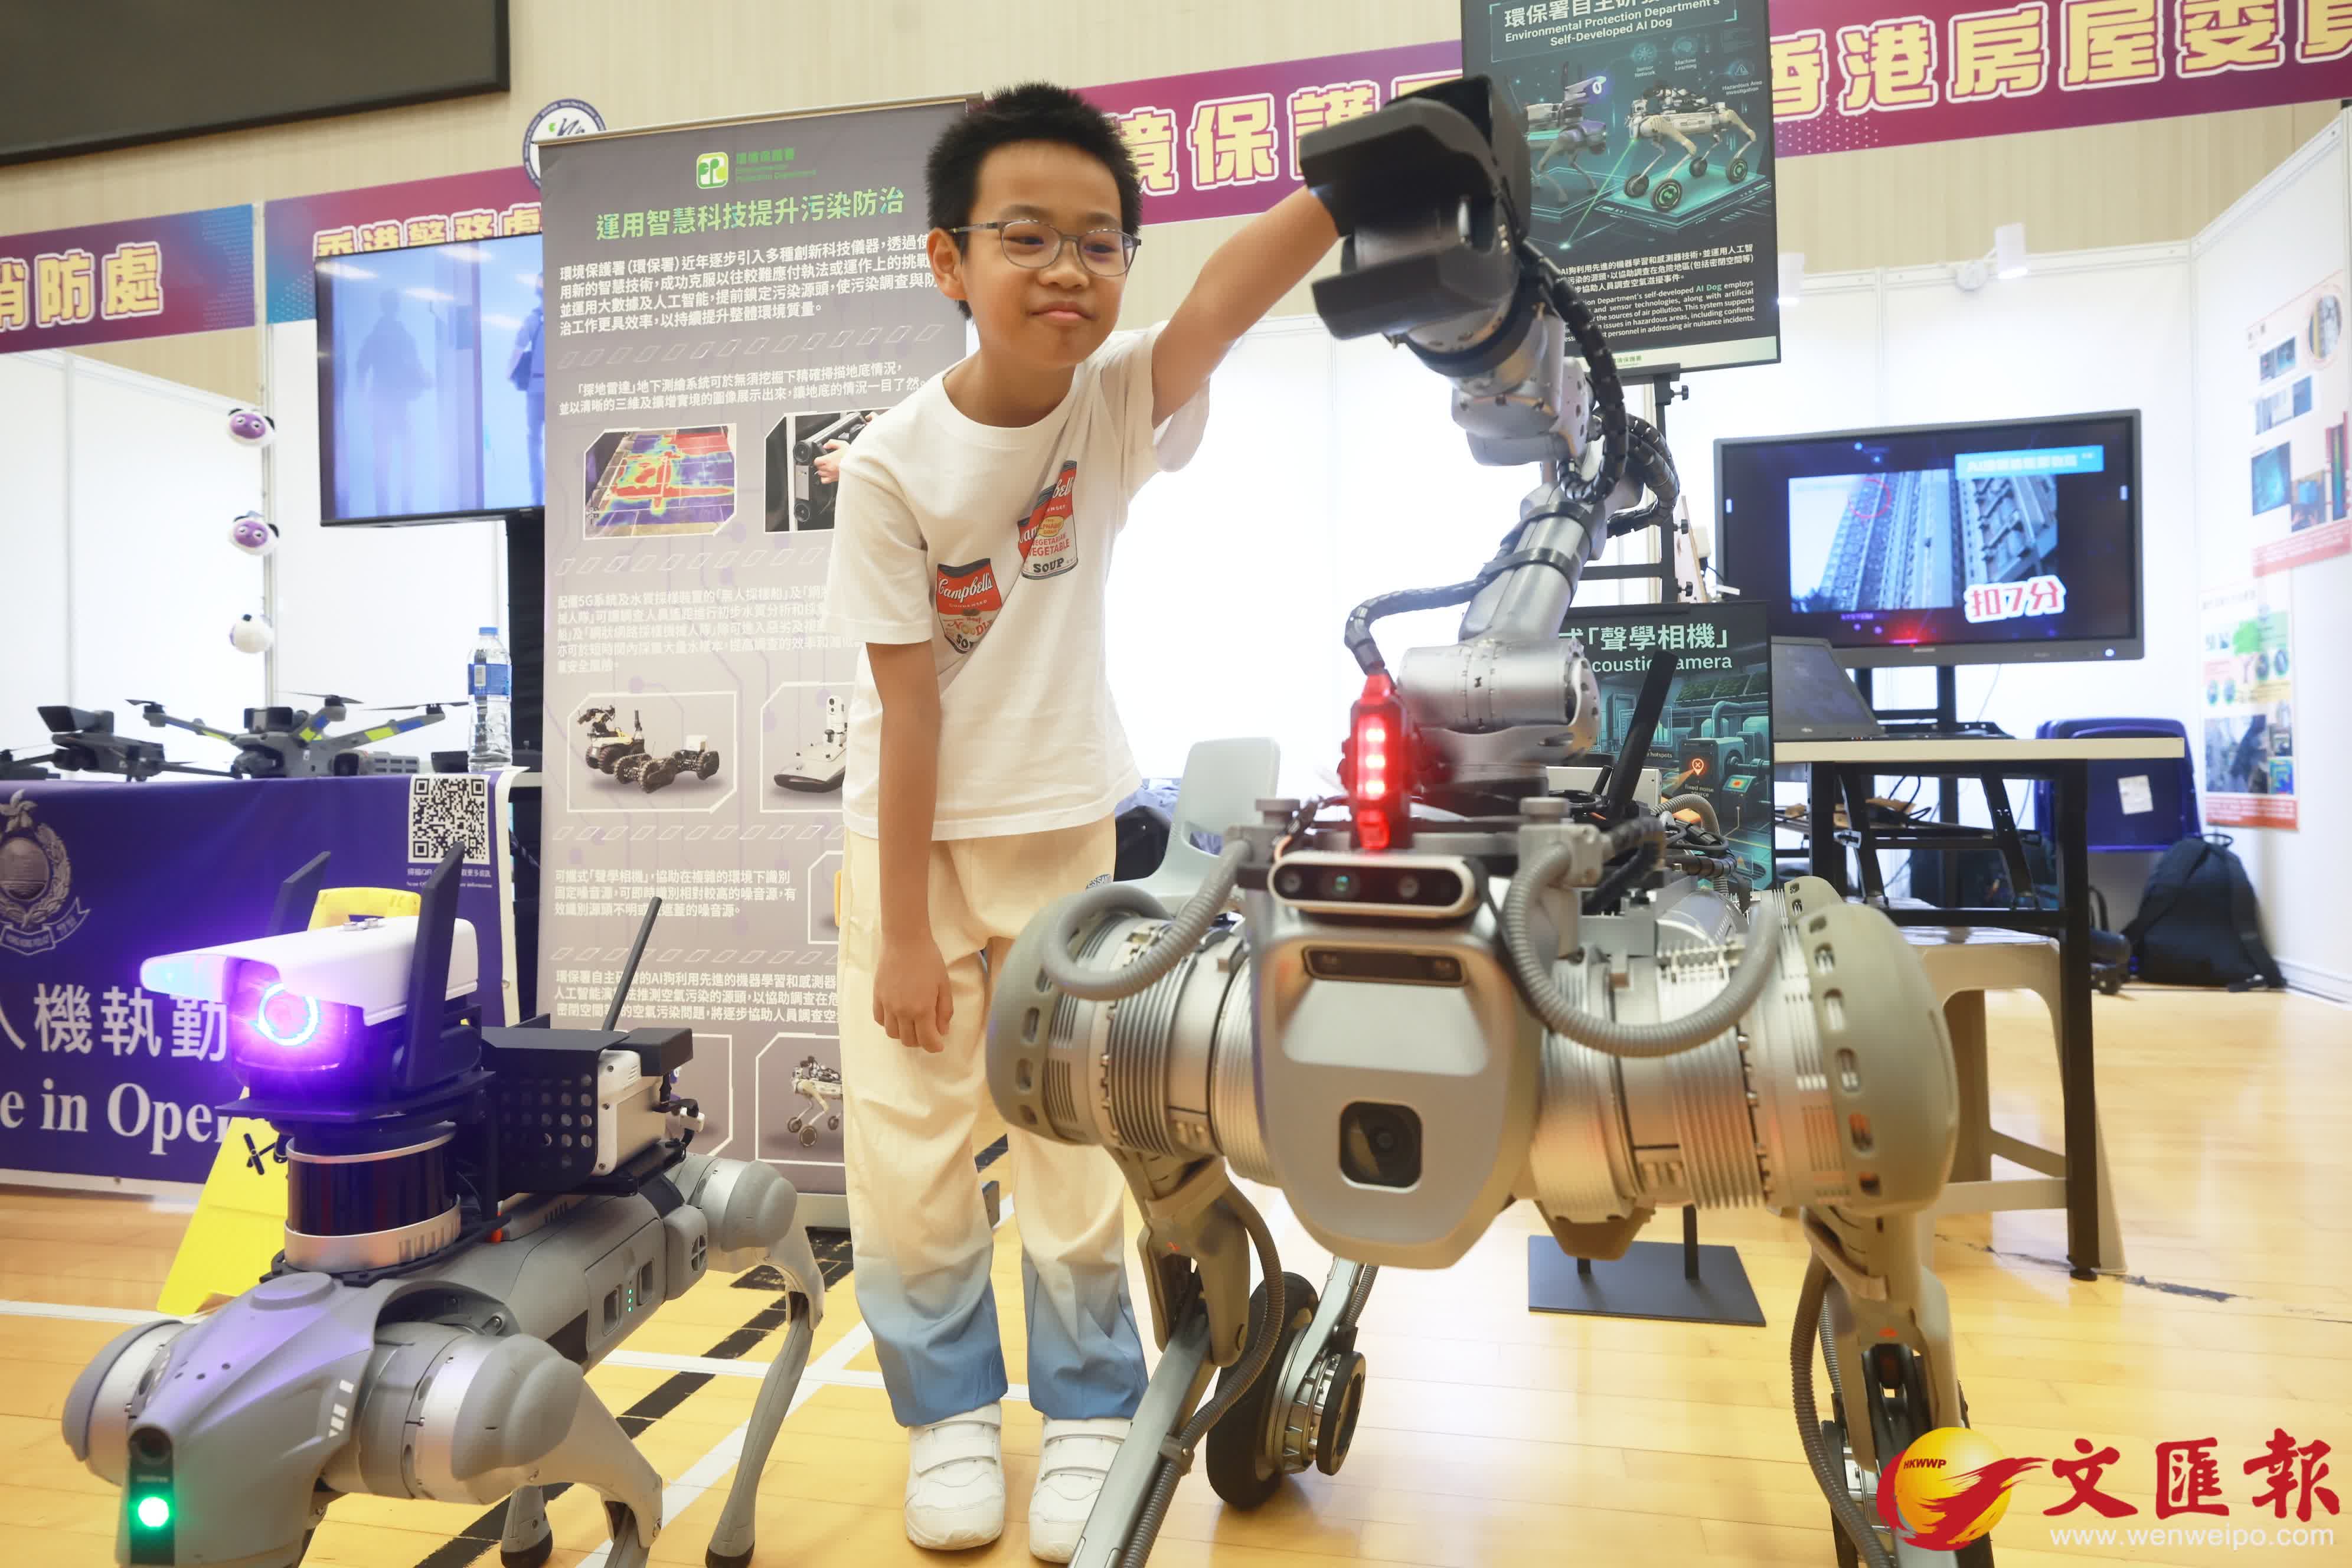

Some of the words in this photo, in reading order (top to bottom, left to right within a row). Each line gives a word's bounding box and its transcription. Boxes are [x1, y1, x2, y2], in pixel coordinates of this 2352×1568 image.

[1505, 21, 1582, 42] Environmental
[1585, 12, 1641, 28] Protection
[1550, 27, 1633, 46] Self-Developed
[1636, 21, 1647, 31] AI
[1651, 18, 1672, 28] Dog
[596, 186, 904, 240] 運用智慧科技提升污染防治
[1598, 293, 1642, 305] Department's
[1644, 286, 1694, 299] self-developed
[1706, 283, 1722, 292] Dog
[1724, 280, 1753, 289] employs
[1724, 288, 1753, 298] artificial
[1633, 316, 1668, 325] hazardous
[1691, 309, 1723, 319] including
[1724, 305, 1754, 315] confined
[1652, 306, 1683, 316] pollution.
[1700, 302, 1723, 310] system
[1724, 297, 1754, 307] supports
[1608, 327, 1639, 338] personnel
[1648, 323, 1683, 332] addressing
[1693, 319, 1722, 327] nuisance
[1723, 315, 1755, 324] incidents.
[1033, 557, 1064, 573] SOUP
[1970, 580, 2060, 618] 扣7分
[40, 1078, 88, 1132] in
